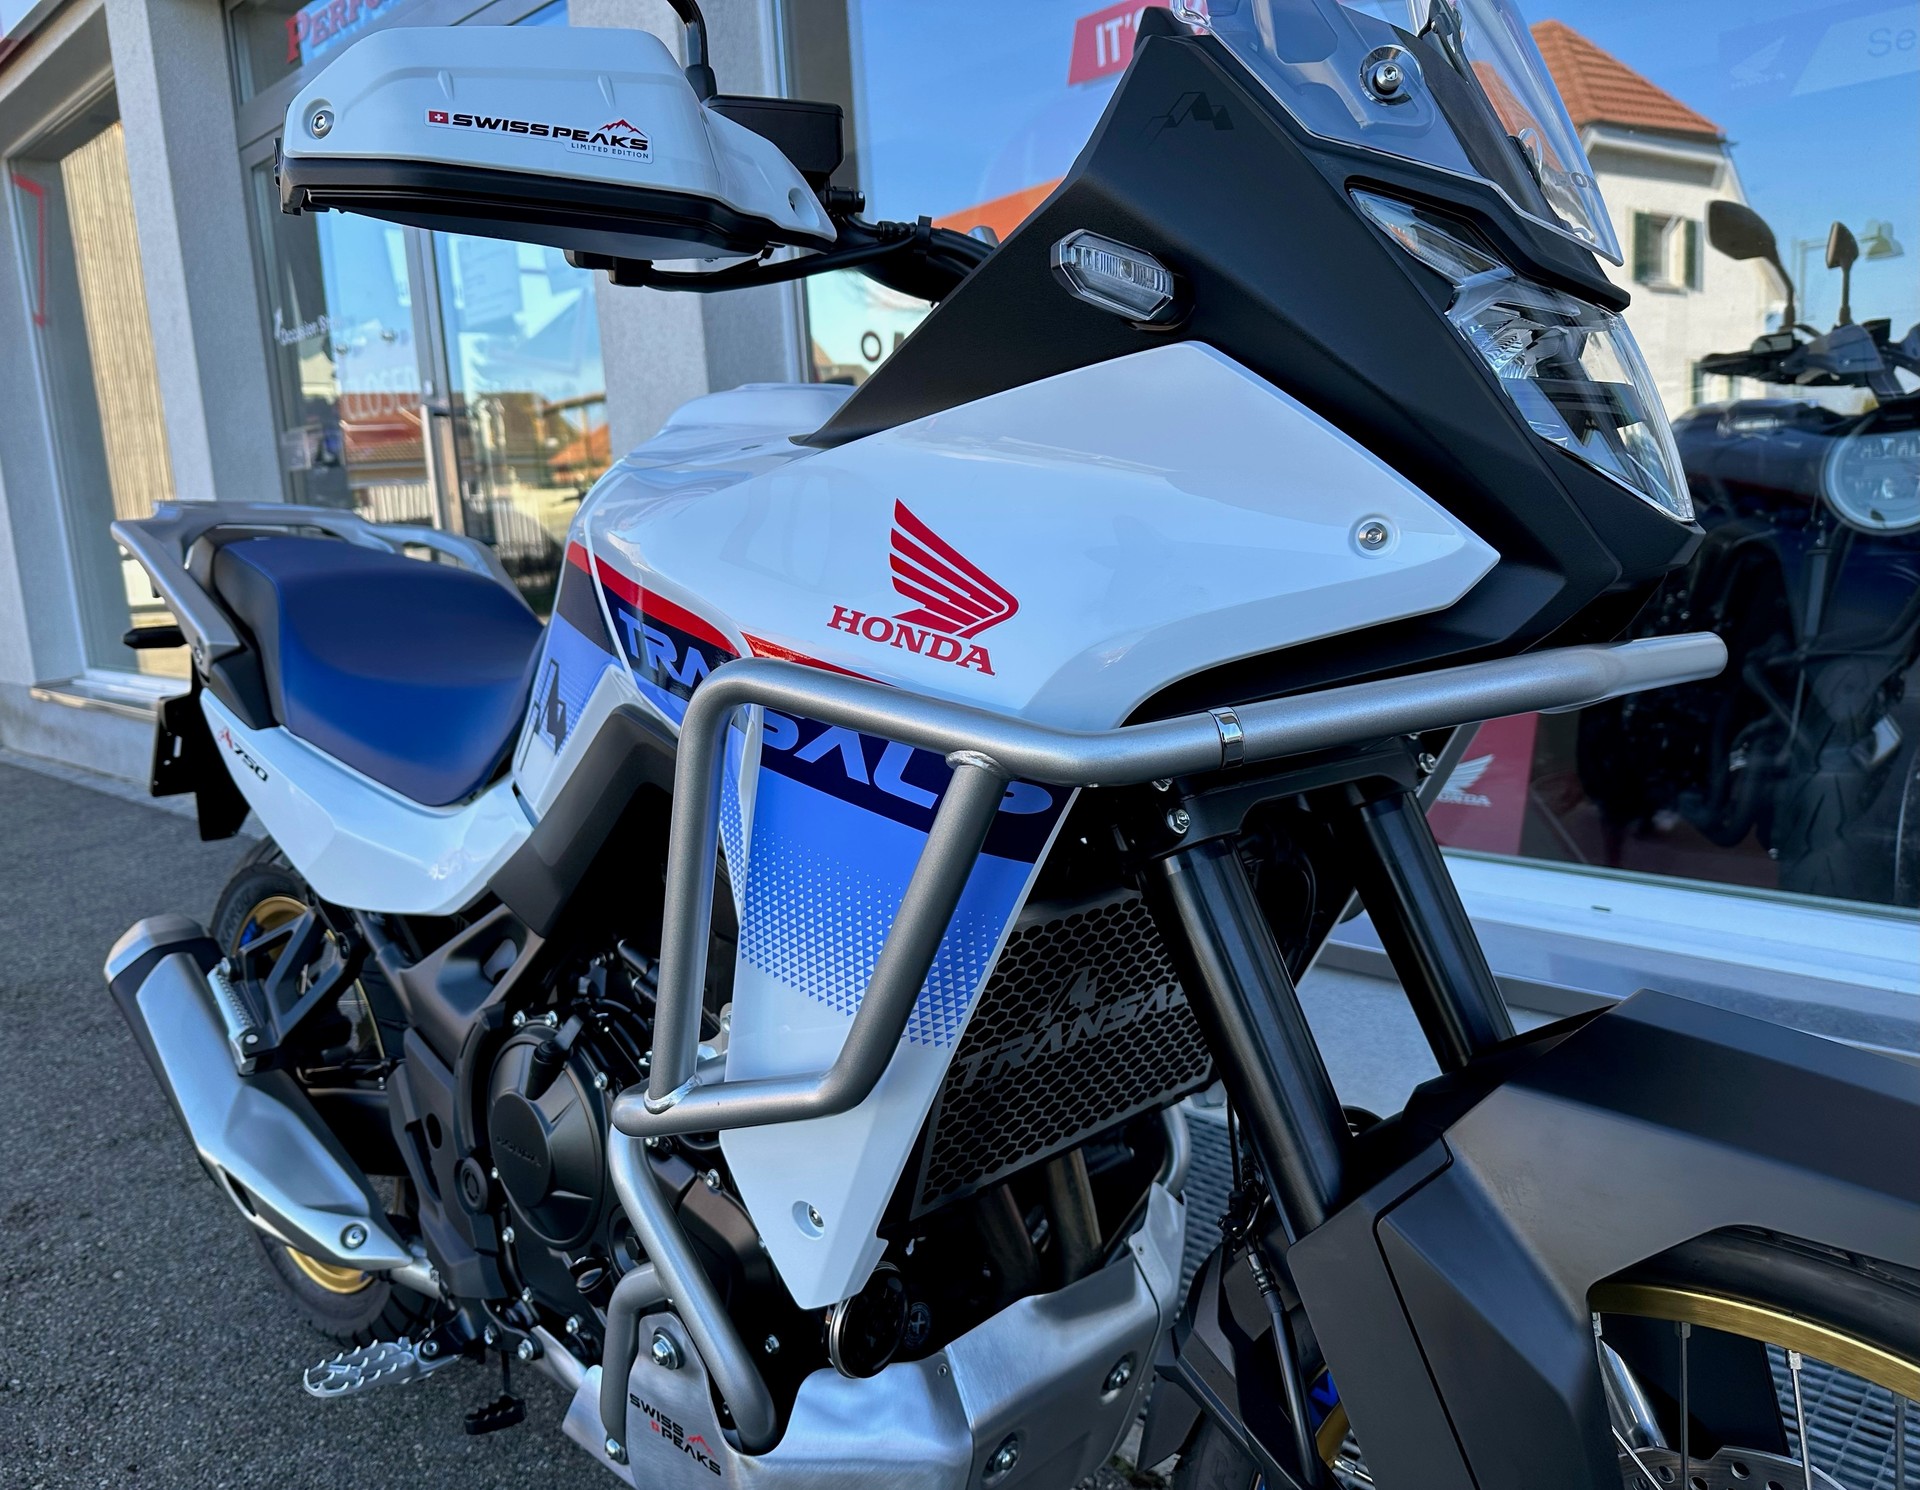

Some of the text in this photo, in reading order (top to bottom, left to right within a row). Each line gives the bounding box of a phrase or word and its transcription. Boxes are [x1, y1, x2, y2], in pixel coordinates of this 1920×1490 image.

[571, 142, 649, 159] LIMITED EDITION
[827, 605, 996, 676] HONDA
[233, 742, 268, 782] 750
[1437, 793, 1491, 807] ONDA
[629, 1393, 684, 1438] SWISS
[661, 1427, 722, 1476] PEAKS
